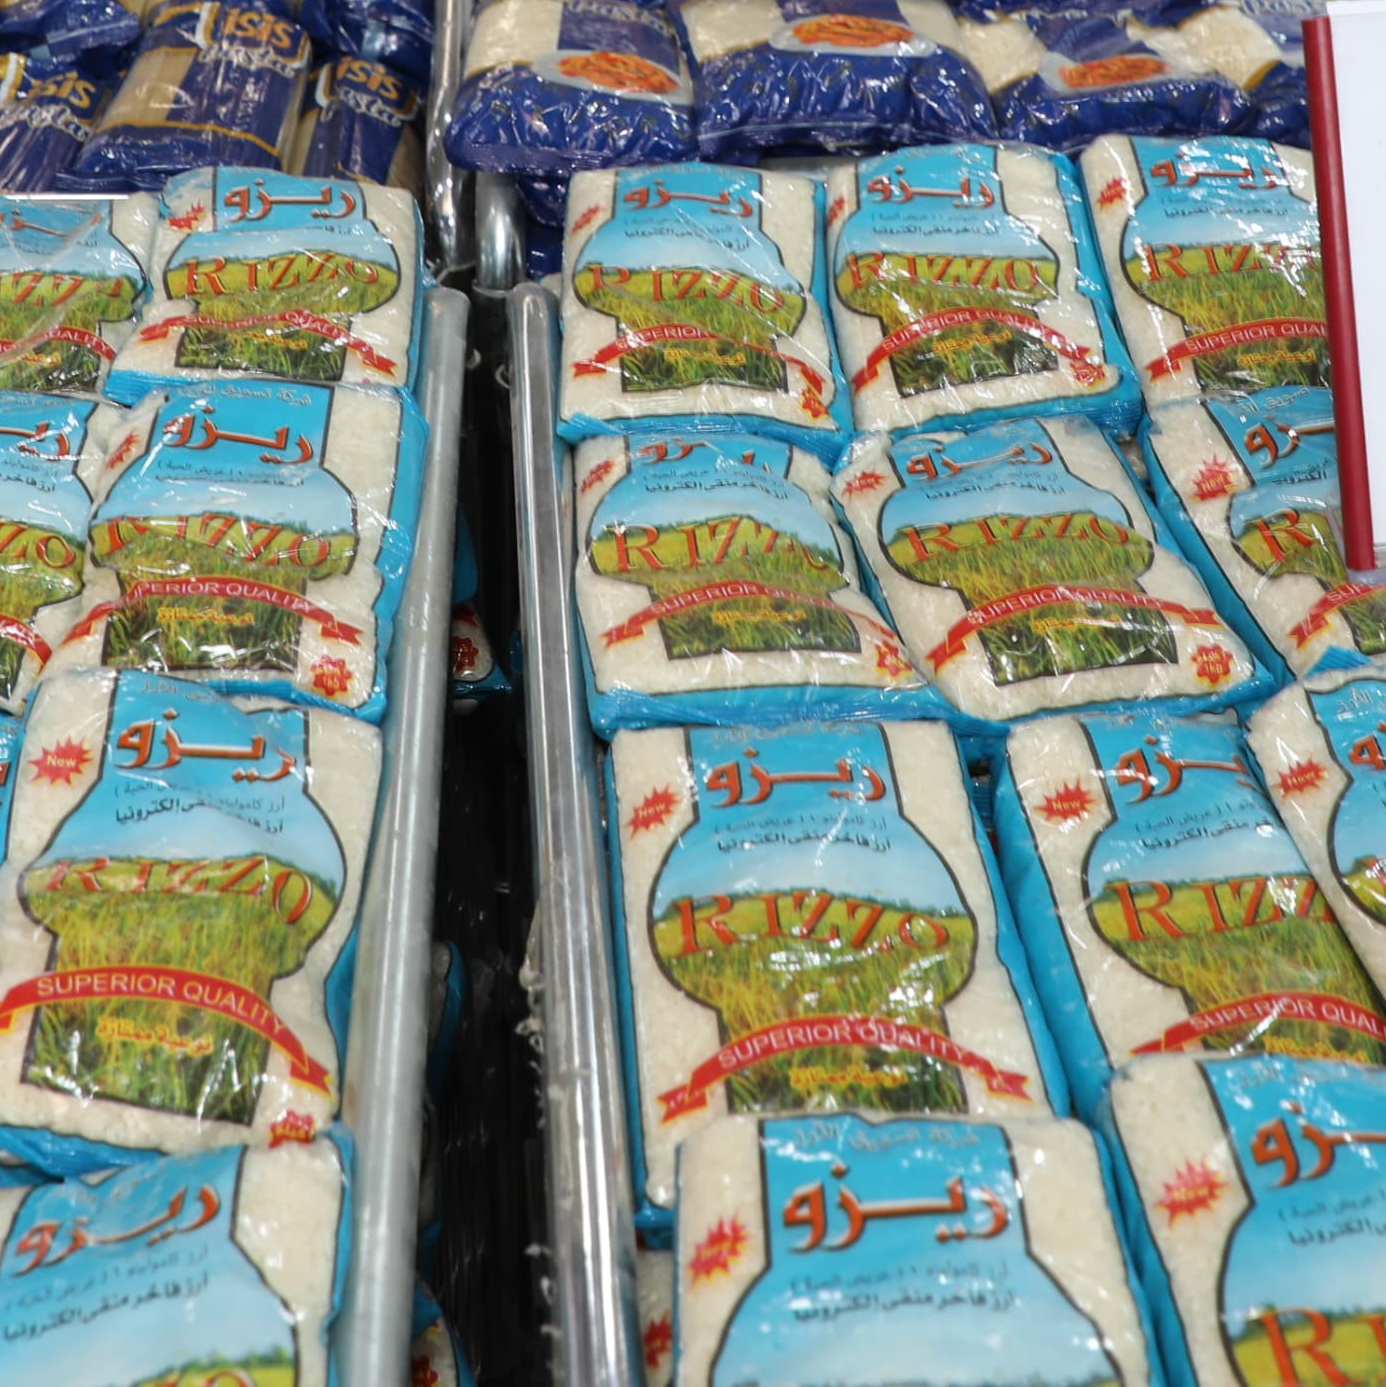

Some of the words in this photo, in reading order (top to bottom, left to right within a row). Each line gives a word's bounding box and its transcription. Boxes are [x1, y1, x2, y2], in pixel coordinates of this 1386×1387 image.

[1150, 154, 1280, 191] ريزو
[223, 179, 358, 223] ريزو
[186, 253, 380, 297] RIZZO
[882, 309, 972, 351] SUPERIOR
[1185, 325, 1279, 353] SUPERIOR
[650, 583, 759, 613] SUPERIOR
[45, 752, 77, 769] New
[114, 707, 297, 783] ريزو
[706, 747, 886, 808] ريزو
[1282, 767, 1317, 790] New
[636, 800, 669, 819] New
[1050, 796, 1083, 814] New
[45, 853, 315, 925] RIZZO
[672, 892, 951, 959] RIZZO
[35, 972, 179, 999] SUPERIOR
[181, 977, 289, 1039] QUALITY
[1187, 999, 1317, 1032] SUPERIOR
[718, 1018, 868, 1068] SUPERIOR
[873, 1021, 969, 1063] QUALITY
[783, 1158, 1009, 1254] ريزو
[10, 1184, 221, 1278] ريزو
